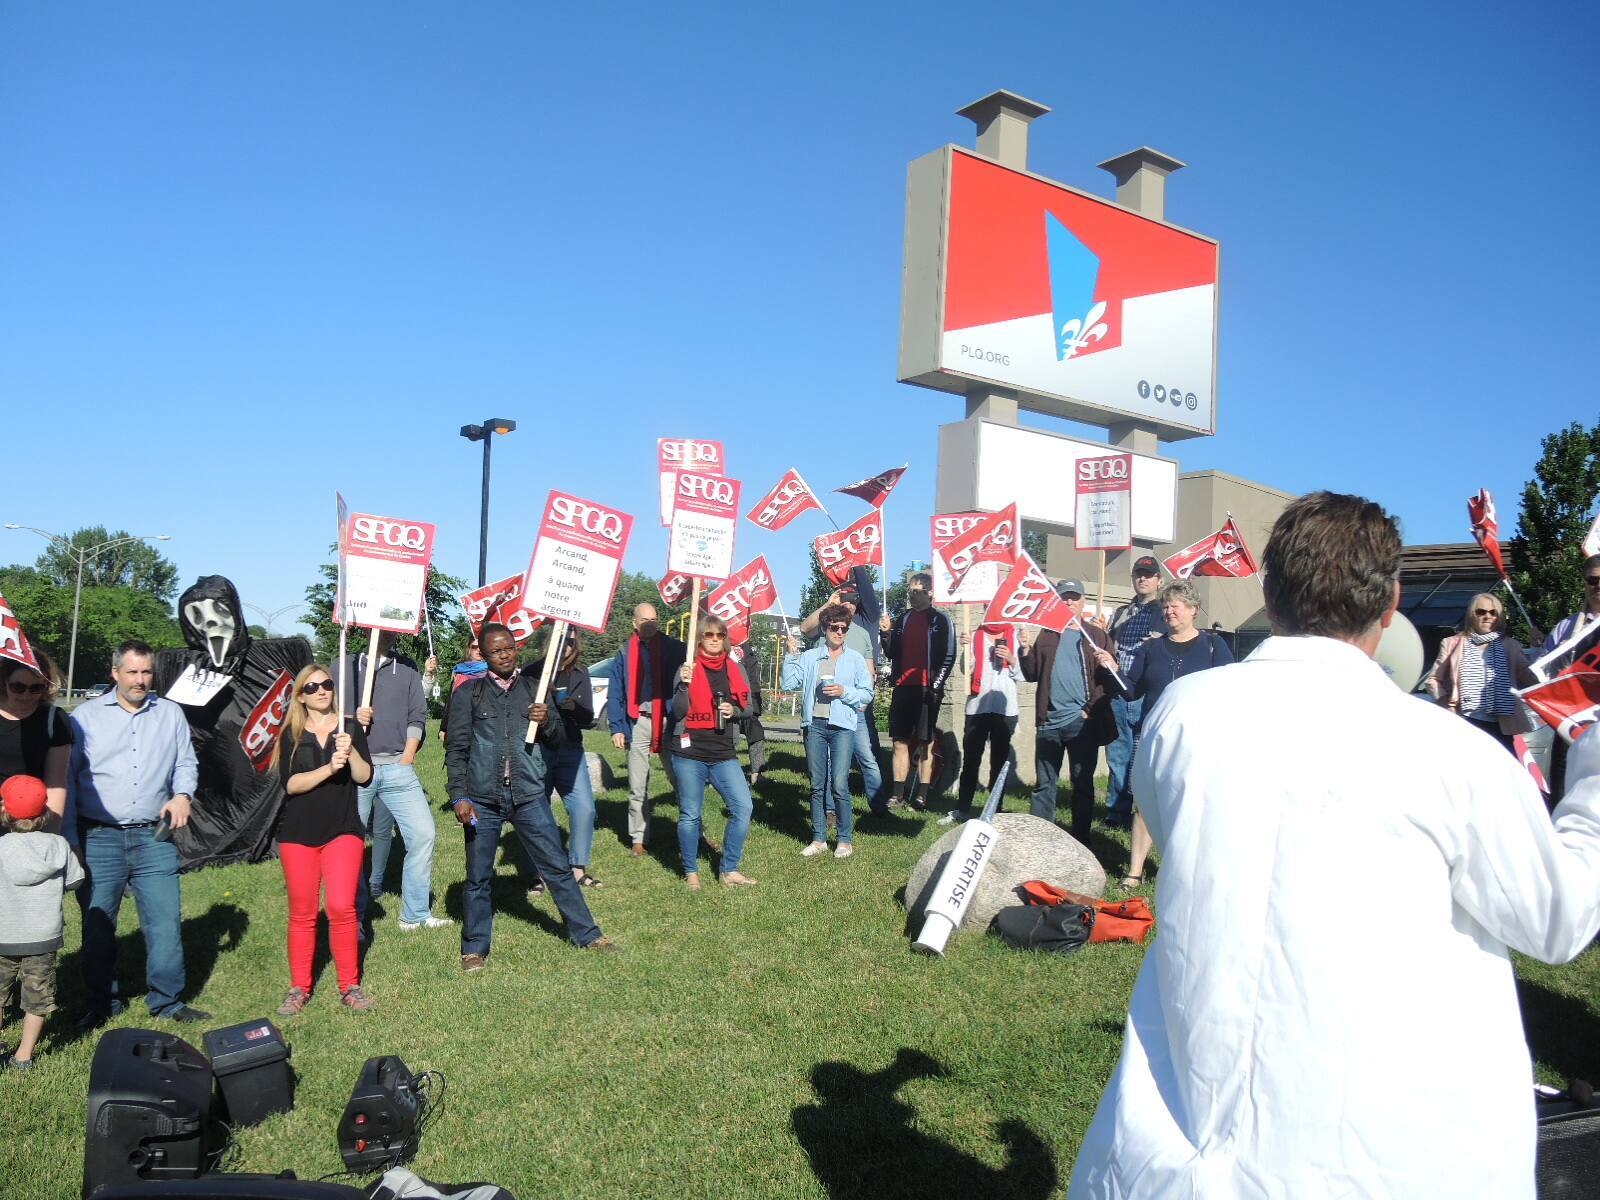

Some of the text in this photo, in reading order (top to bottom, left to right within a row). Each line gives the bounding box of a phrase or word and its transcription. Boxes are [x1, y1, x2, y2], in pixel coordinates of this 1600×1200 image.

[961, 344, 1011, 367] PLQ.ORG
[1078, 457, 1128, 481] SPGQ
[678, 473, 734, 506] SPGQ
[758, 479, 808, 526] SPGQ
[548, 496, 624, 544] SPGQ
[352, 517, 426, 551] SPGQ
[820, 523, 881, 568] SPGQ
[555, 545, 589, 563] Arcand,
[551, 559, 586, 576] Arcand,
[544, 590, 570, 603] notre
[556, 579, 585, 593] quand
[541, 603, 571, 617] argent
[948, 832, 991, 909] EXPERTISE
